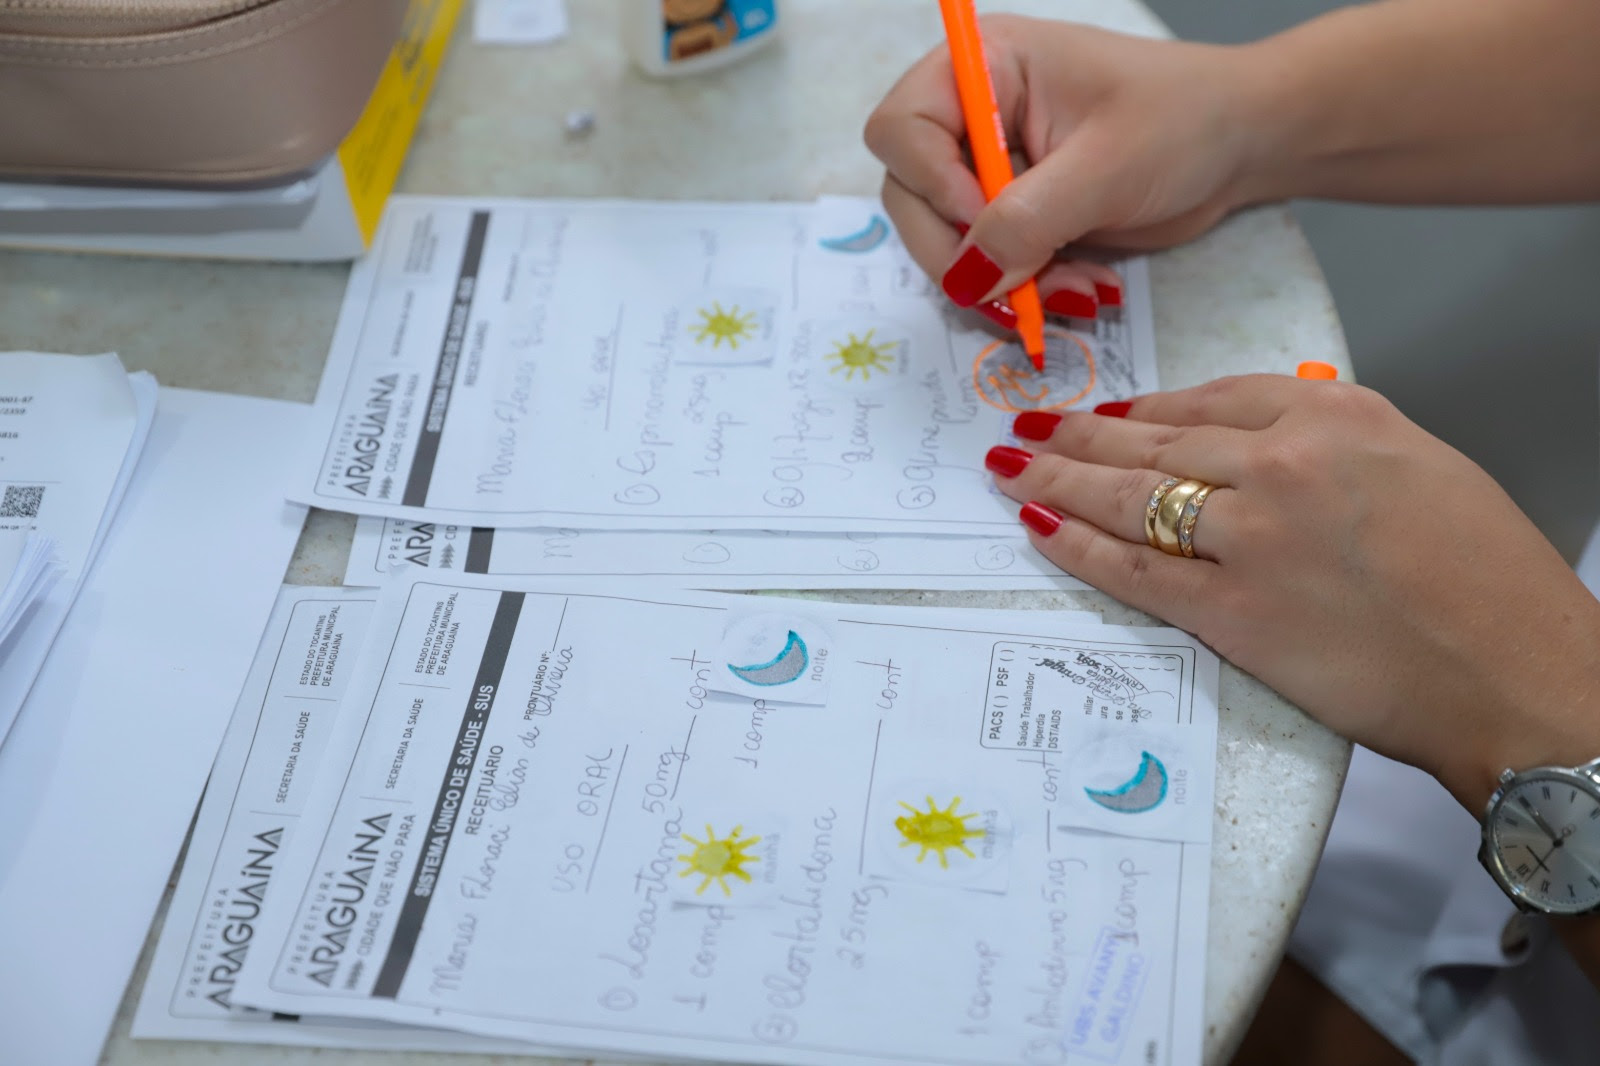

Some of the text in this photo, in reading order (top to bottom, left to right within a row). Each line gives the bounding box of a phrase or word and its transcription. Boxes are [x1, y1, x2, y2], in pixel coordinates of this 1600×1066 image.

[328, 415, 356, 486] PREFEITURA
[344, 373, 399, 496] ARAGUAÍNA
[300, 614, 326, 685] ESTADO DO TOCANTINS
[310, 604, 341, 686] PREFEITURA MUNICIPAL
[322, 633, 344, 687] DE ARAGUAÍNA
[415, 602, 444, 673] ESTADO DO TOCANTINS
[425, 592, 458, 674] PREFEITURA MUNICIPAL
[436, 622, 460, 676] DE ARAGUAÍNA
[524, 666, 547, 722] PRONTUÁRIO
[811, 647, 828, 683] noite
[996, 666, 1010, 688] PSF
[478, 684, 494, 712] SUS
[989, 710, 1004, 740] PACS
[1017, 672, 1036, 747] Saúde Trabalhador
[1048, 710, 1062, 748] DST/AIDS
[1116, 710, 1124, 720] se
[276, 711, 311, 804] SECRETARIA DA SAÚDE
[386, 698, 424, 790] SECRETARIA DA SAÚDE
[456, 726, 484, 767] SAÚDE
[1032, 714, 1046, 748] Hiperdia
[450, 768, 468, 788] DE
[465, 745, 504, 836] RECEITUÁRIO
[576, 746, 614, 817] ORAL
[1174, 768, 1188, 806] noite
[434, 788, 461, 834] ÚNICO
[358, 814, 416, 957] CIDADE QUE NÃO PARA
[414, 836, 448, 898] SISTEMA
[206, 827, 284, 1010] ARAGUAÍNA
[306, 812, 392, 989] ARAGUAÍNA
